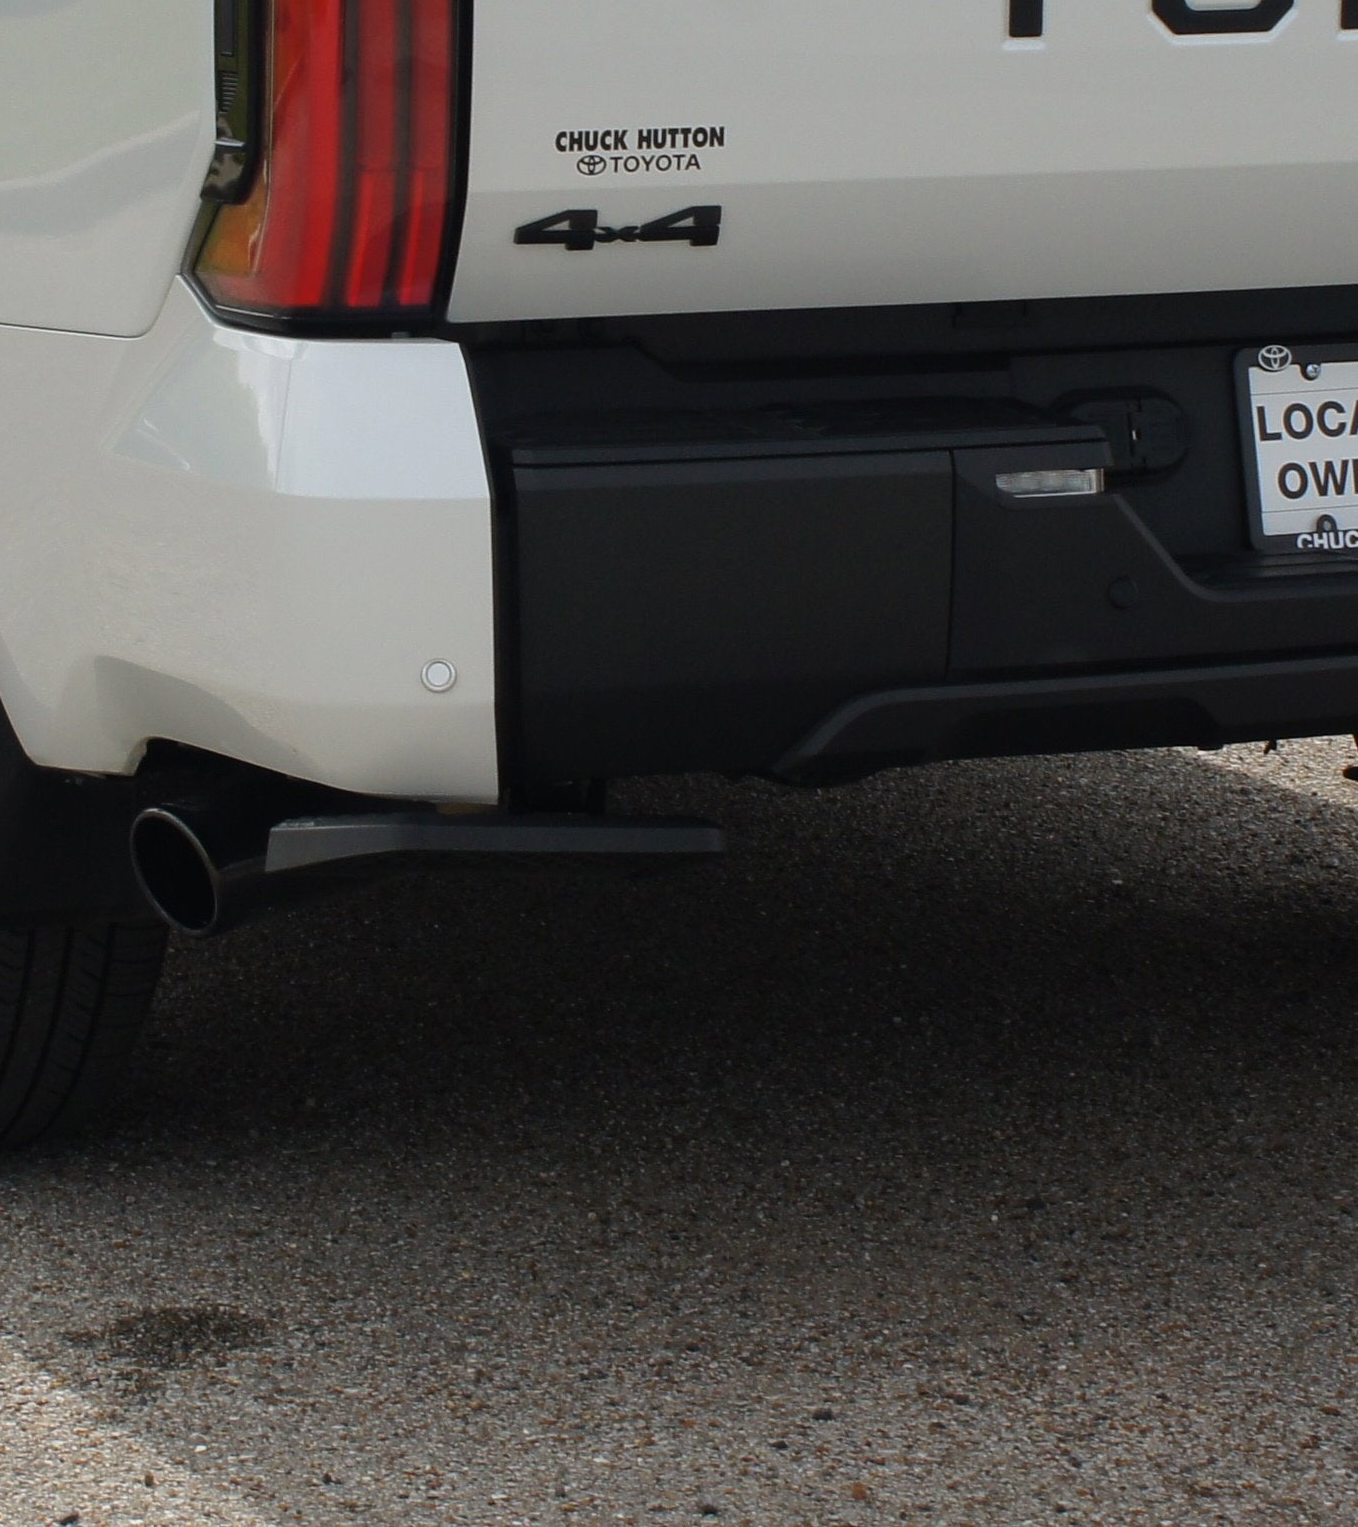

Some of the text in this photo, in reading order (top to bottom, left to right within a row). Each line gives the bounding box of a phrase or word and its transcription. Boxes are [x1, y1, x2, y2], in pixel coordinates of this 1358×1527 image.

[555, 126, 725, 152] CHUCK HUTTON
[609, 153, 701, 173] TOYOTA
